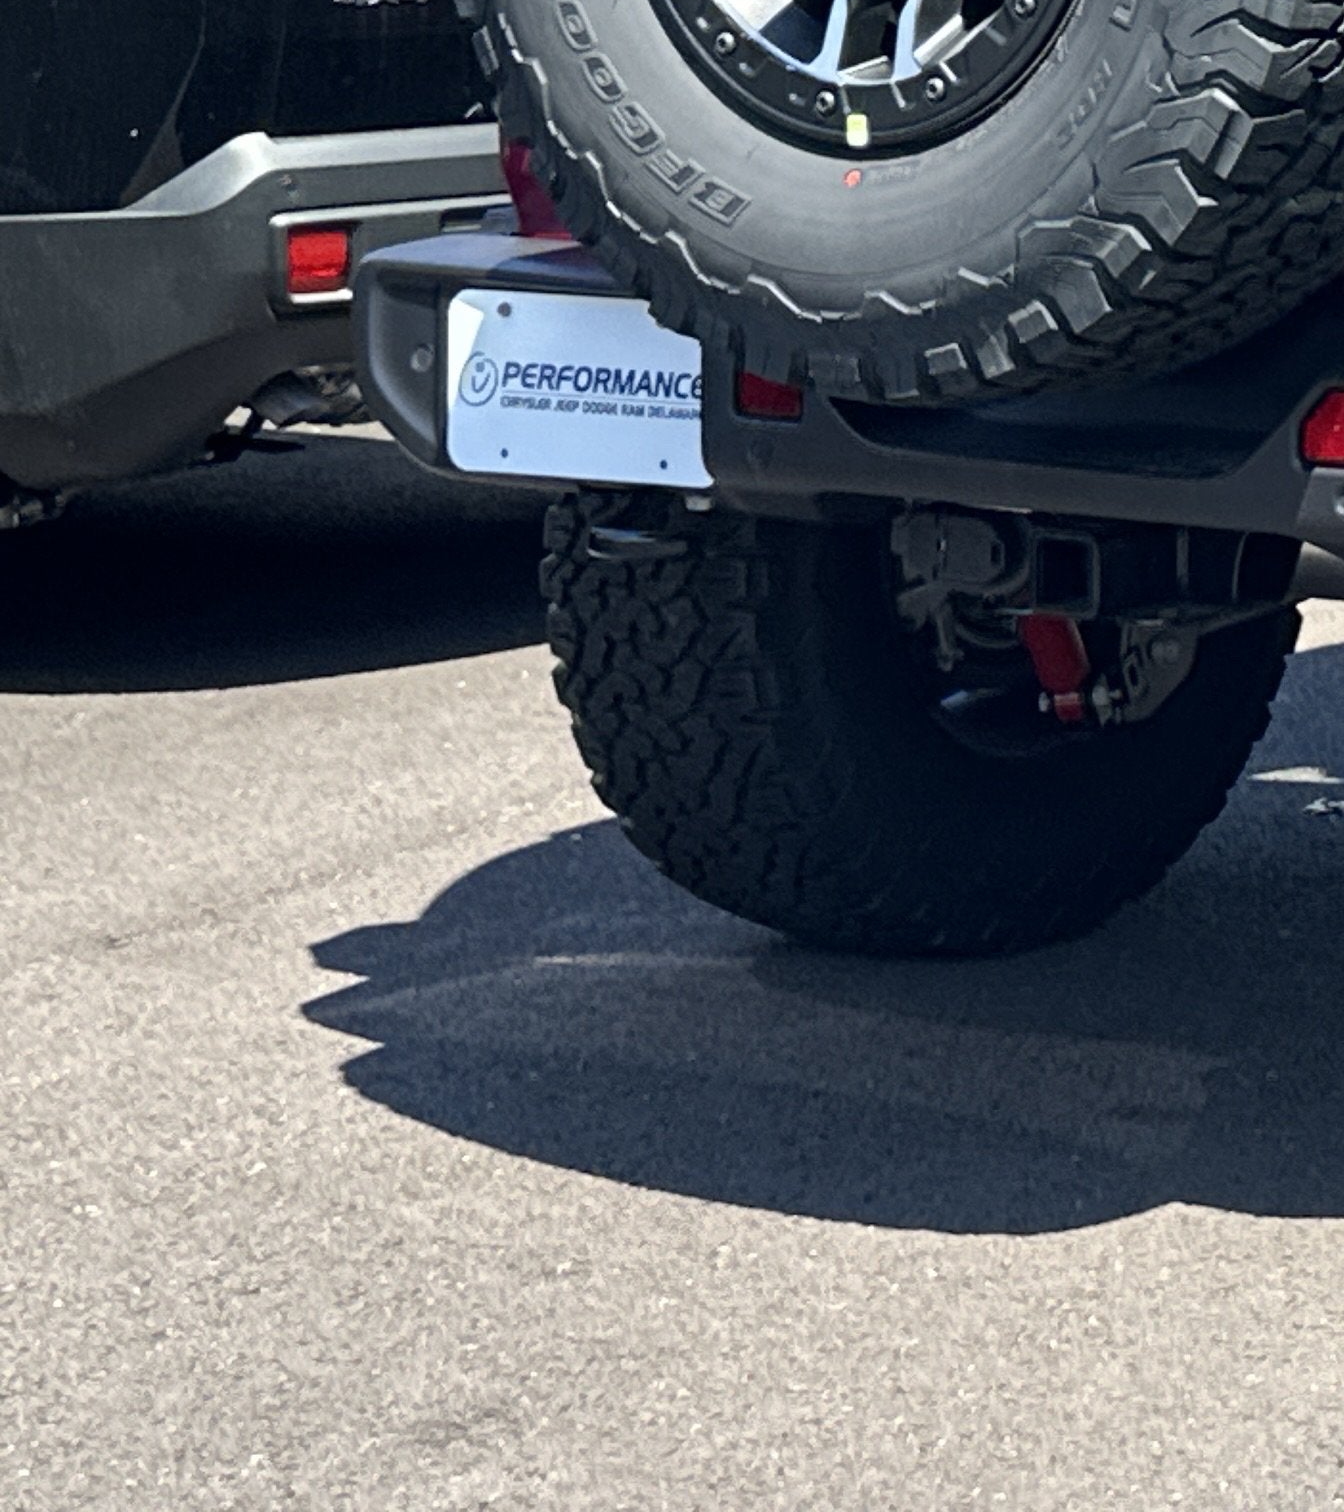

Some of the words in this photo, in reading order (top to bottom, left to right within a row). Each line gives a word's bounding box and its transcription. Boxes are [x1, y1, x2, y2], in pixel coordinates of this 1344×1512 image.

[502, 361, 702, 400] PERFORMANCE
[500, 395, 552, 412] CHRYSLER
[553, 399, 580, 413] JEEP
[582, 400, 618, 417] DODGE
[620, 403, 645, 418] RAM
